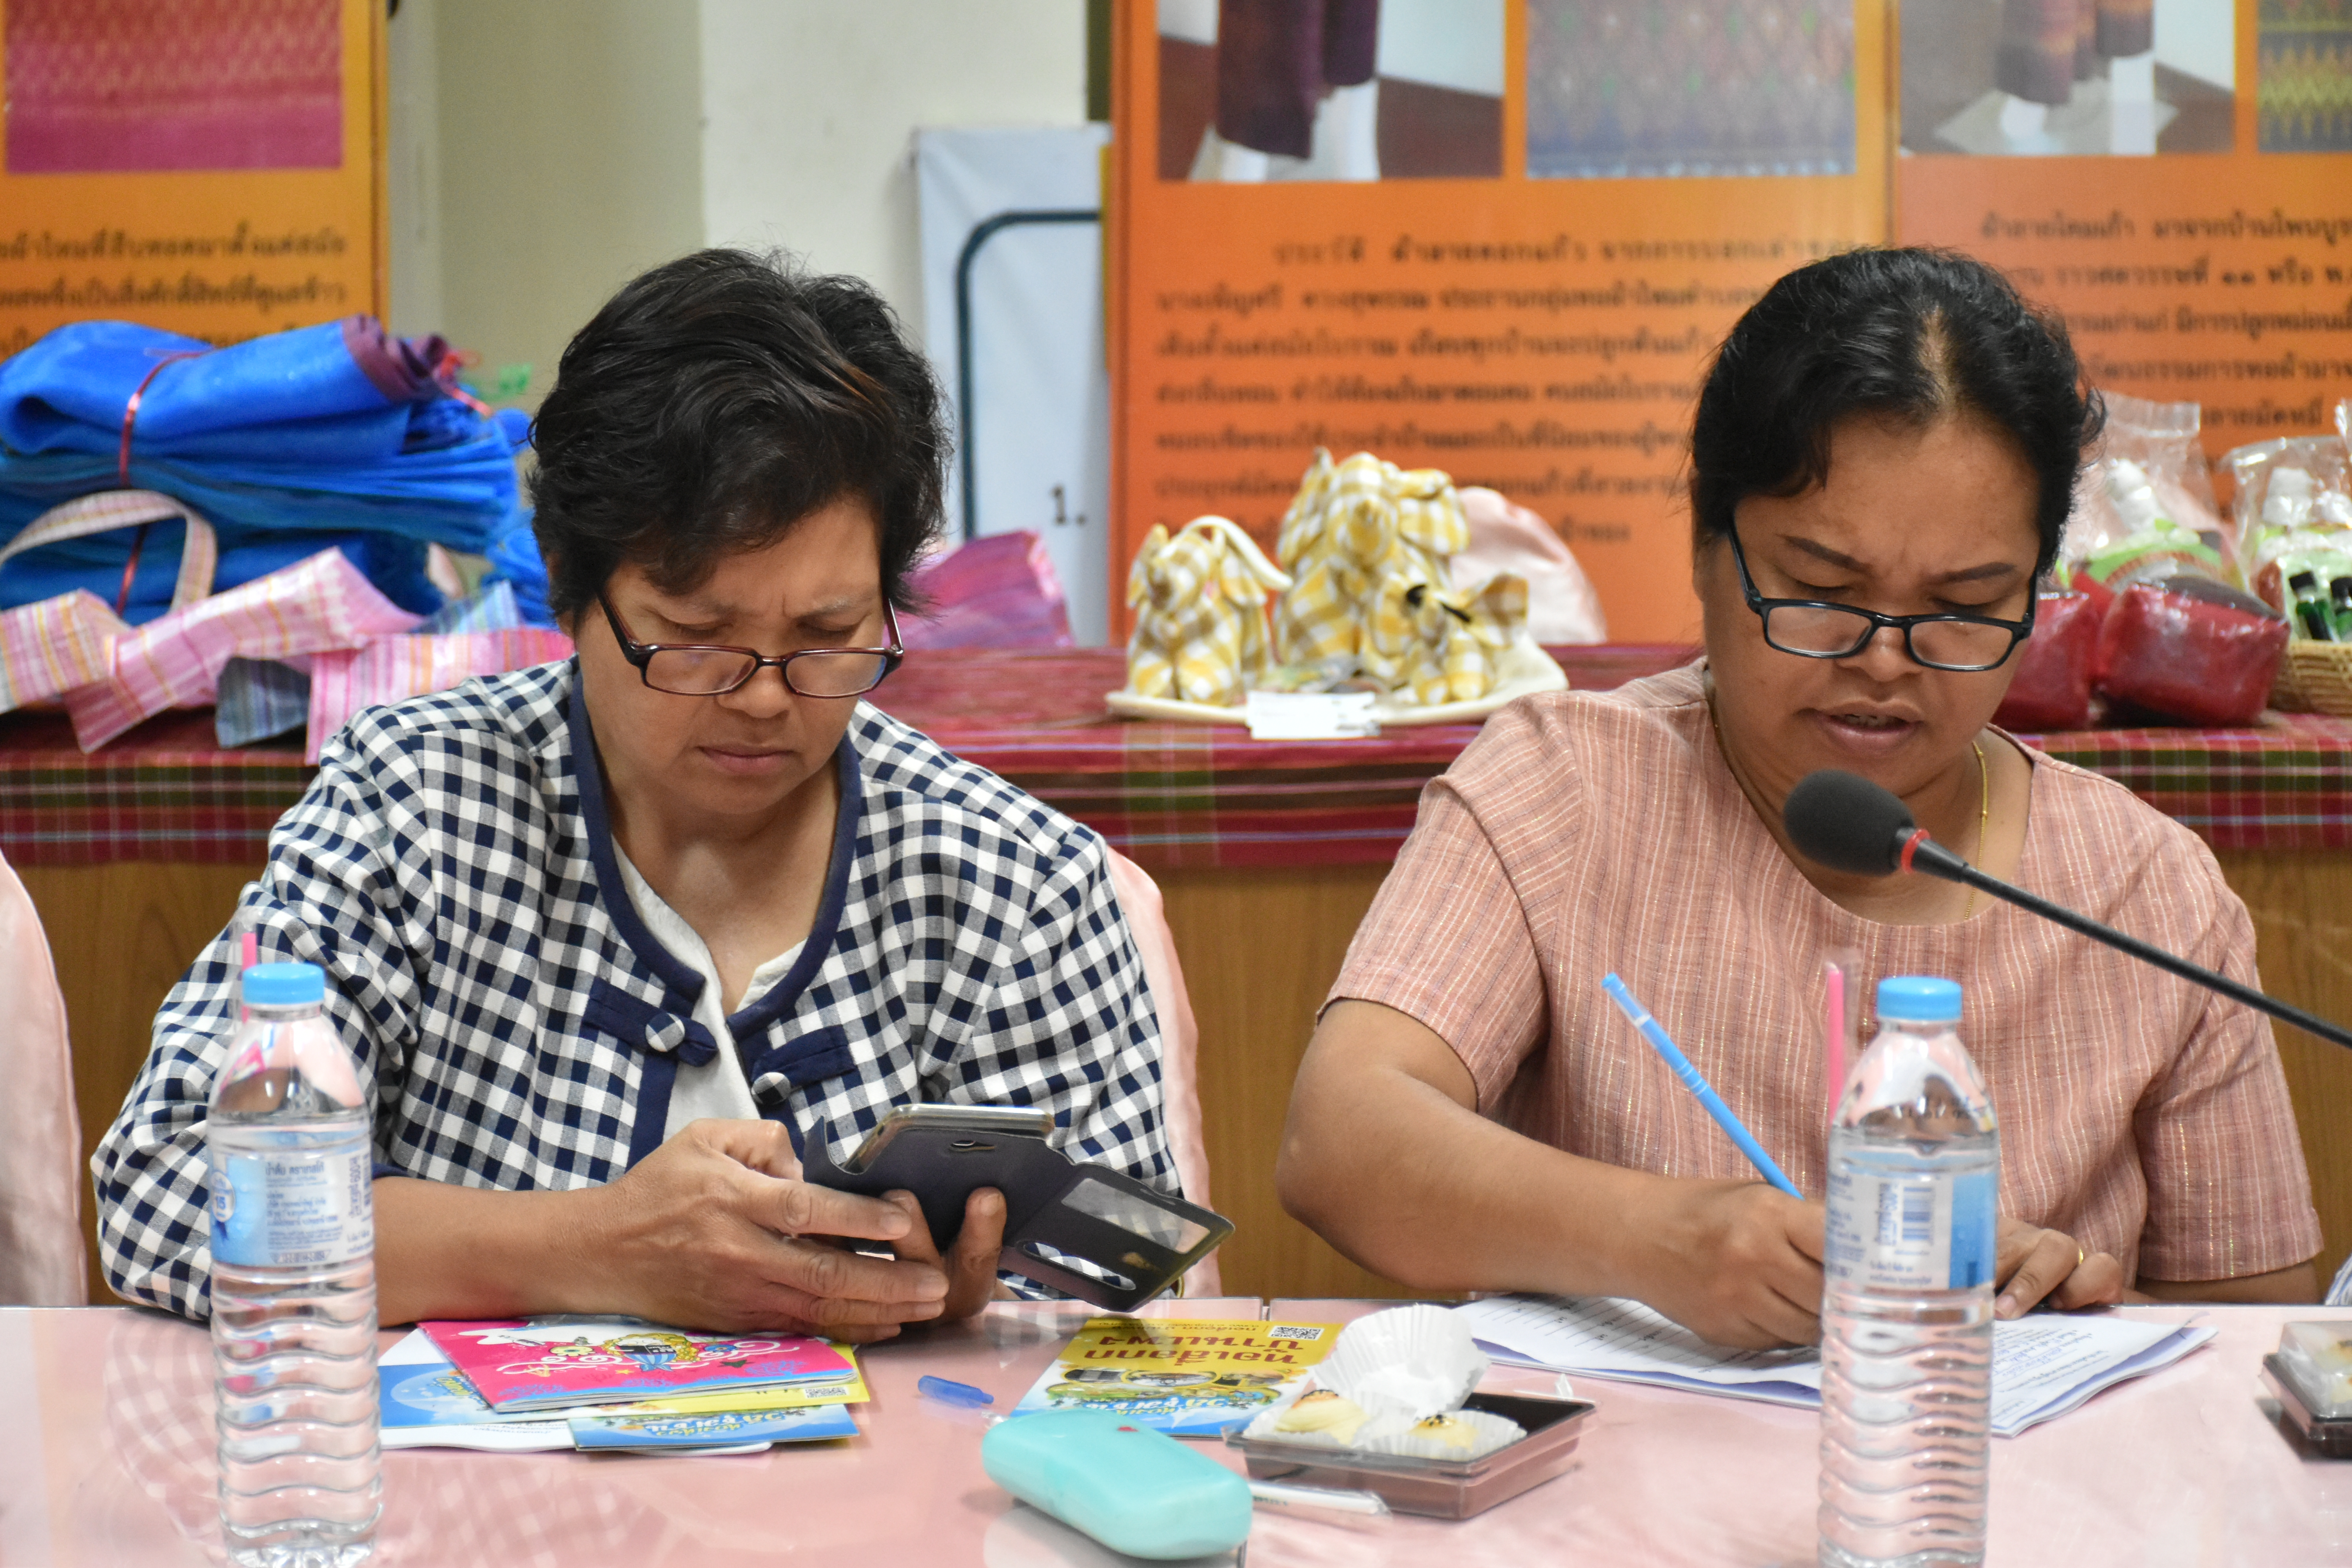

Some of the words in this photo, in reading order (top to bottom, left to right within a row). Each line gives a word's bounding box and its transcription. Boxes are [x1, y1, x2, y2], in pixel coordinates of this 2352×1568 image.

[1100, 1335, 1304, 1353] บ้านแพง
[1085, 1348, 1301, 1367] ทอเสื่อกก
